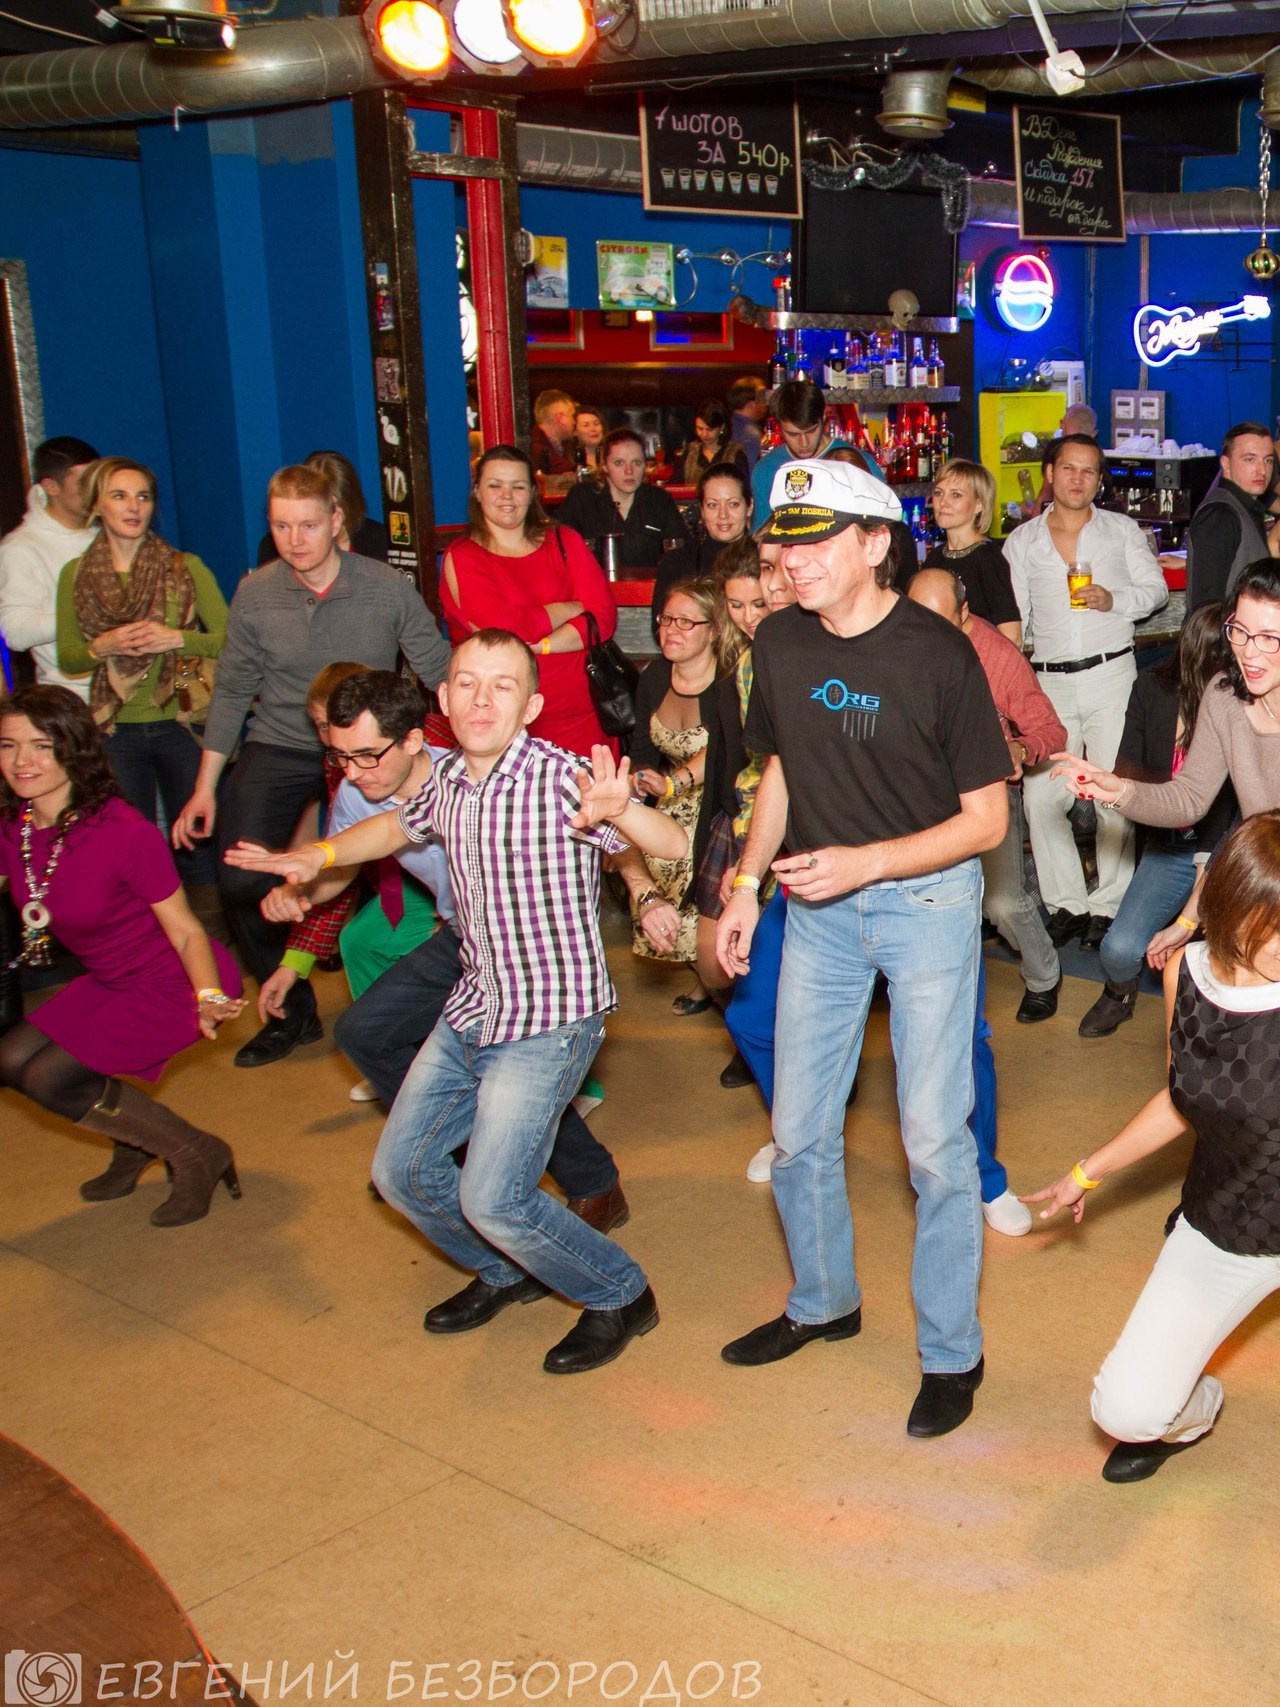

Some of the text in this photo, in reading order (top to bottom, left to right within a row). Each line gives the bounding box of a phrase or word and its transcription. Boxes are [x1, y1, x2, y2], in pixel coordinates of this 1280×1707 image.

[672, 113, 743, 140] ШОТОВ
[697, 140, 726, 164] ЗА
[1047, 140, 1103, 168] Рождения
[1024, 159, 1096, 189] Скидка 15%
[1037, 185, 1084, 218] подарок
[1067, 206, 1112, 235] от бара
[809, 679, 880, 711] ZORG
